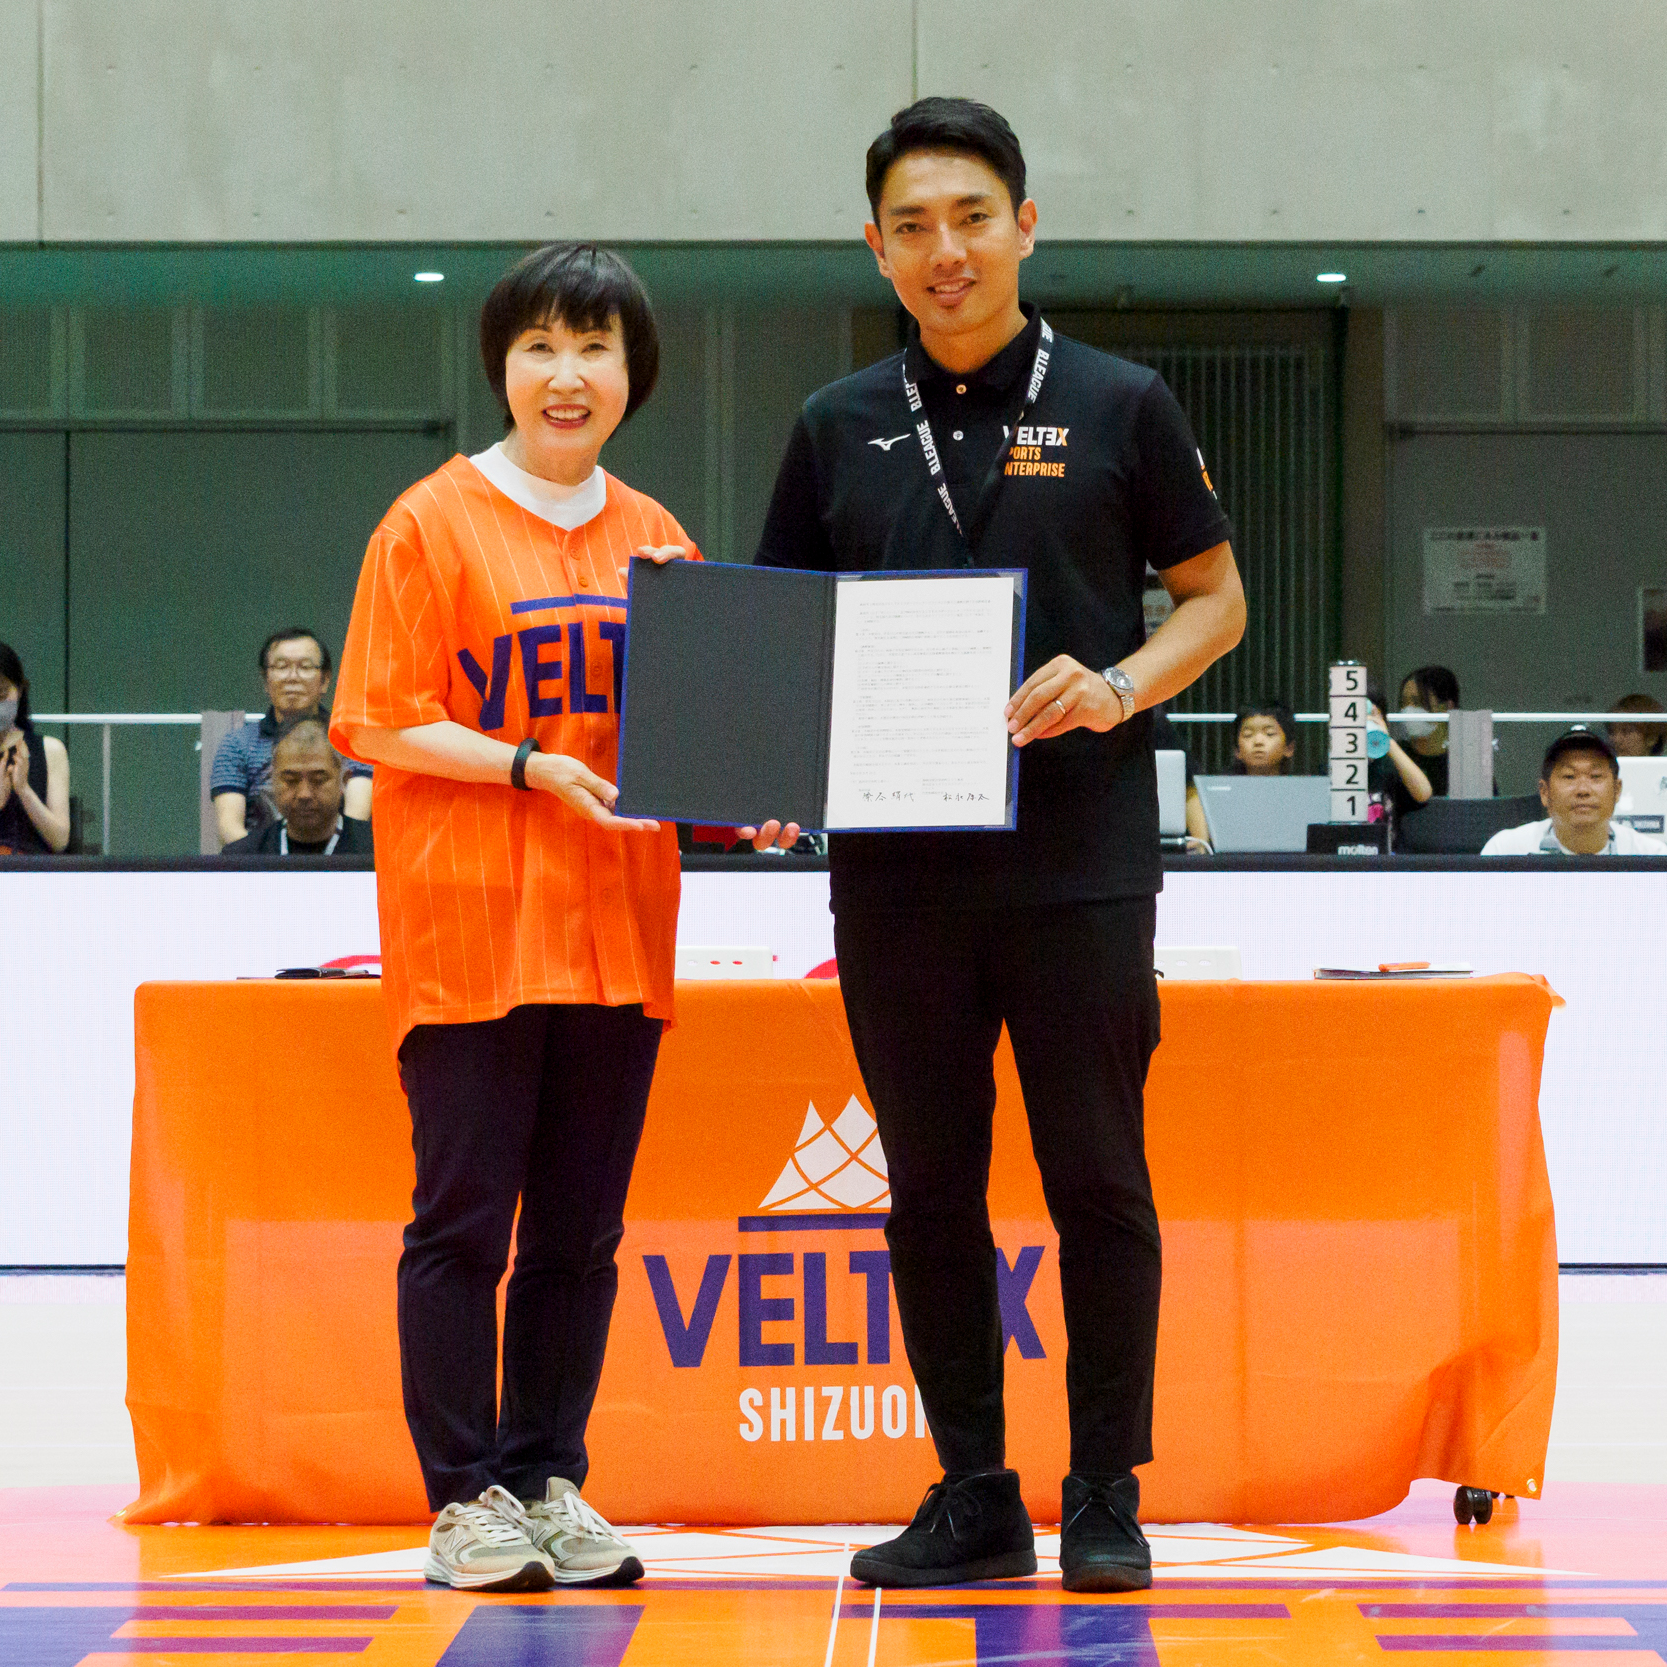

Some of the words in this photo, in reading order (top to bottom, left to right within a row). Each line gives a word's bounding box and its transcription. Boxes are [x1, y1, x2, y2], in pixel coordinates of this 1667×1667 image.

[1009, 446, 1041, 460] ORTS
[1004, 462, 1065, 477] NTERPRISE
[457, 621, 627, 731] VELT
[1346, 670, 1358, 691] 5
[1344, 702, 1357, 722] 4
[1346, 733, 1358, 754] 3
[1346, 764, 1359, 785] 2
[1346, 795, 1356, 816] 1
[642, 1246, 1047, 1368] VELTX
[739, 1385, 934, 1442] SHIZUO
